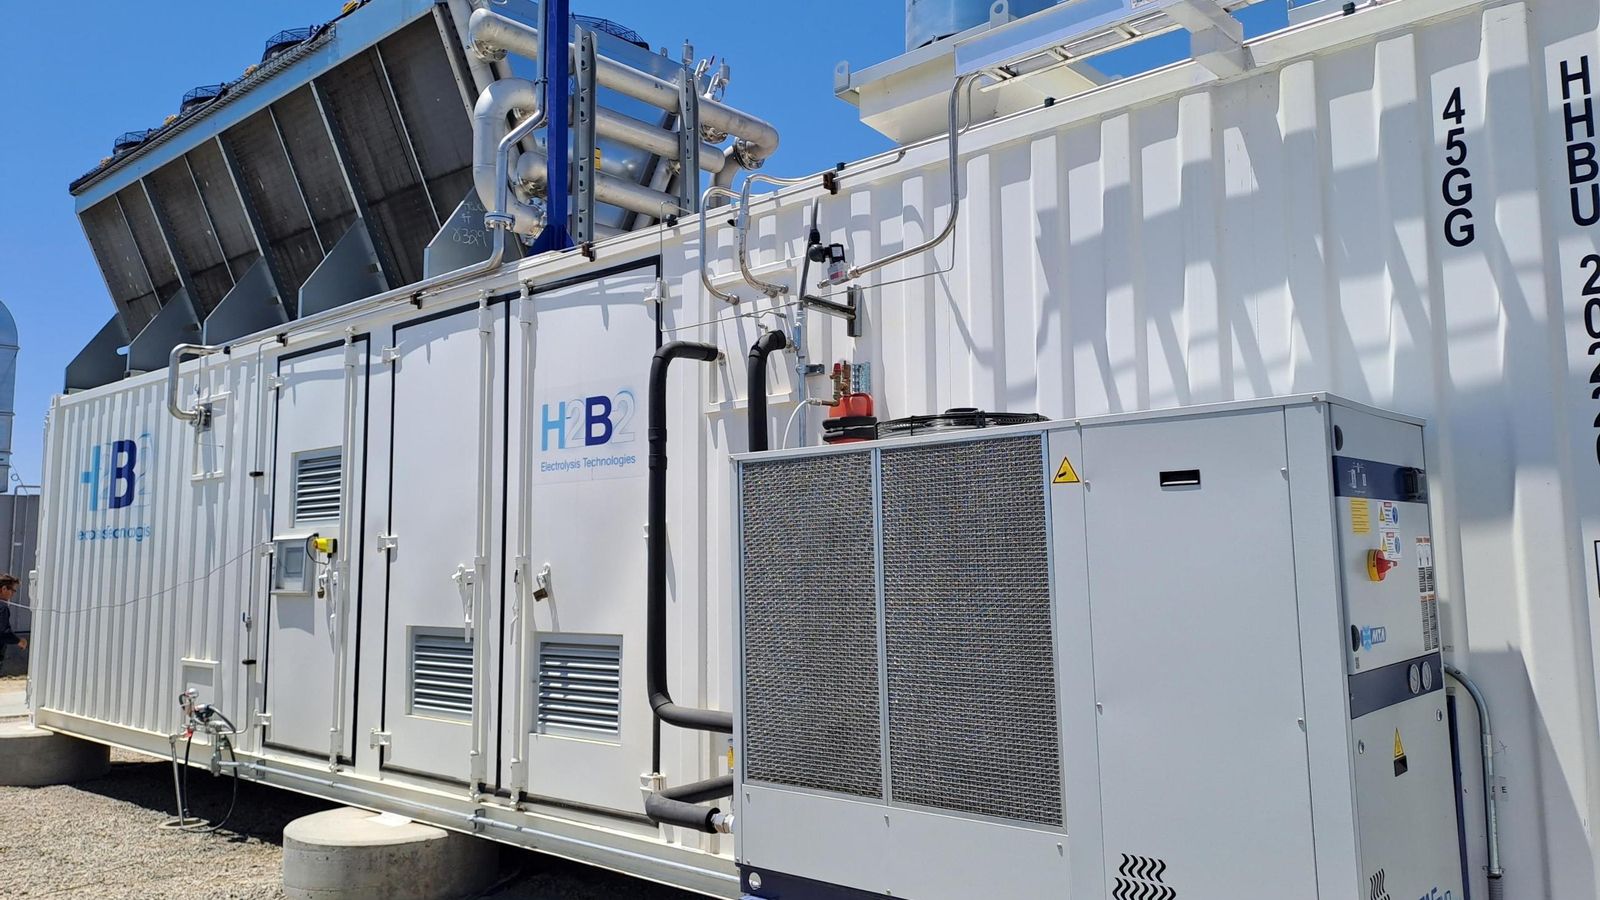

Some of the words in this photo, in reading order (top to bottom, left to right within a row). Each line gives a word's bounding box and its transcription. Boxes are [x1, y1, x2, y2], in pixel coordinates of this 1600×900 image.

[1442, 86, 1475, 248] 45GG
[1560, 55, 1600, 227] HHBU
[540, 460, 581, 473] Electrolysis
[583, 454, 637, 468] Technologies
[541, 390, 636, 452] H2B2
